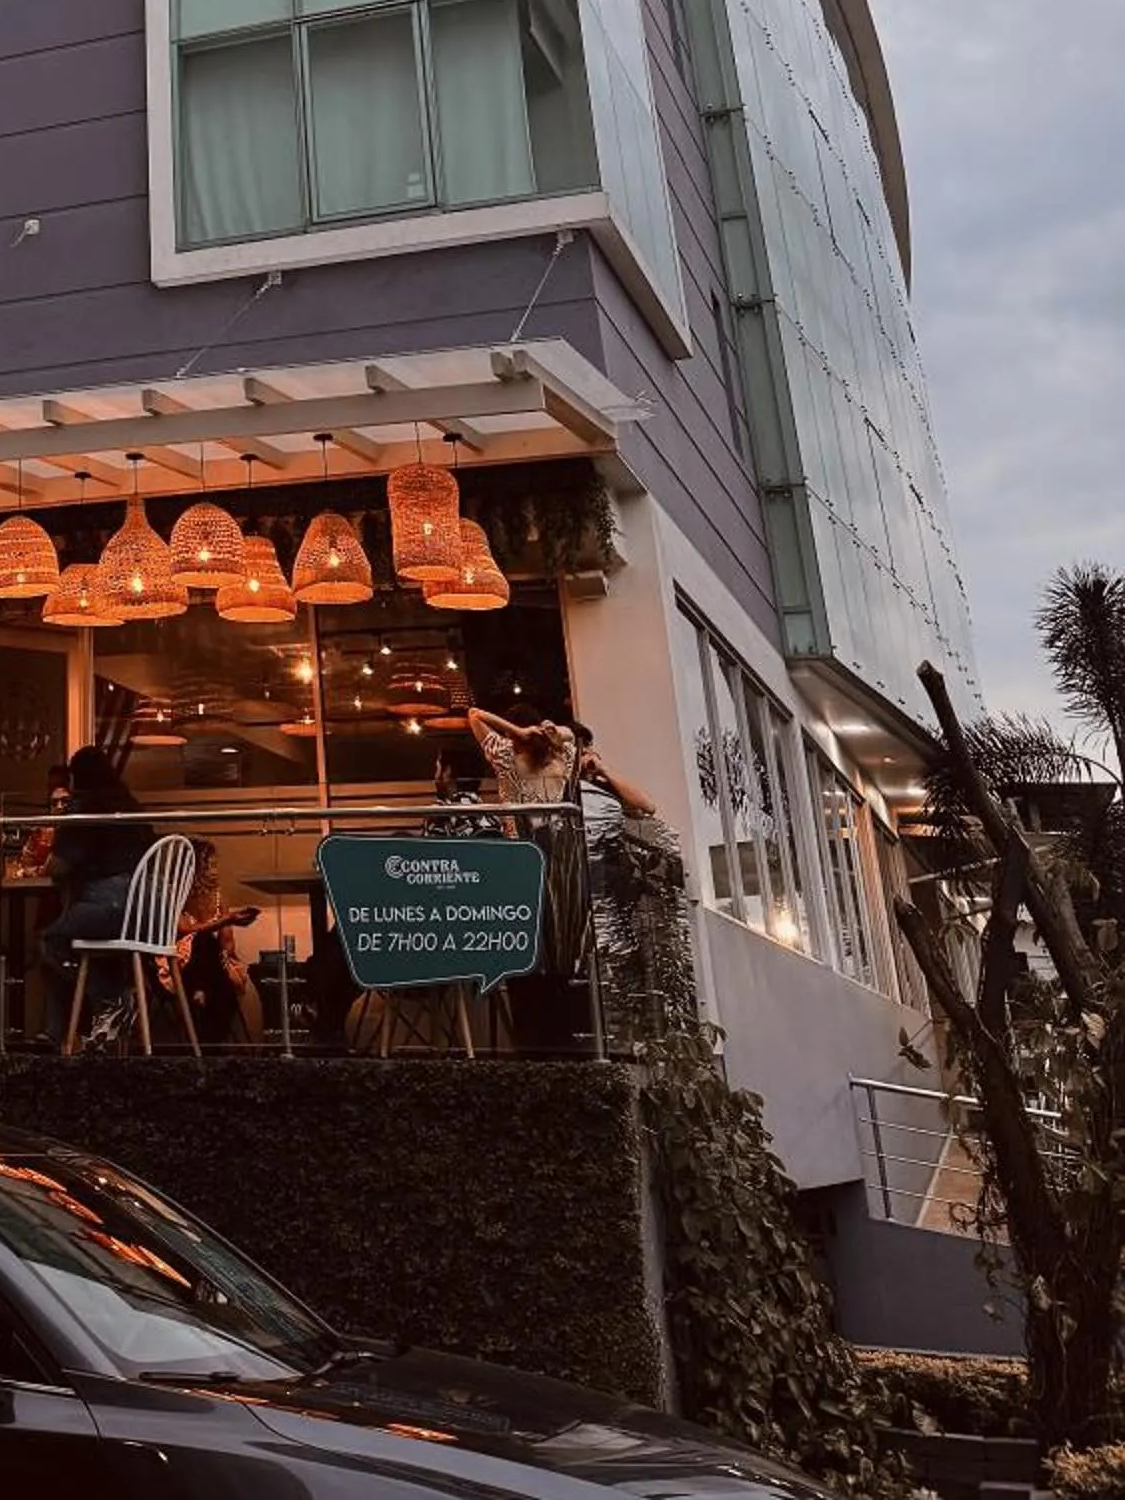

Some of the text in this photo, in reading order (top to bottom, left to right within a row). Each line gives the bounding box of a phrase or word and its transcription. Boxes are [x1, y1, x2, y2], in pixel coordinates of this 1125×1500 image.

[401, 859, 460, 874] CONTRA
[406, 871, 480, 885] CORRIENTE
[349, 905, 532, 923] DE LUNES A DOMINGO
[358, 931, 529, 951] DE 7H00 A 22H00
